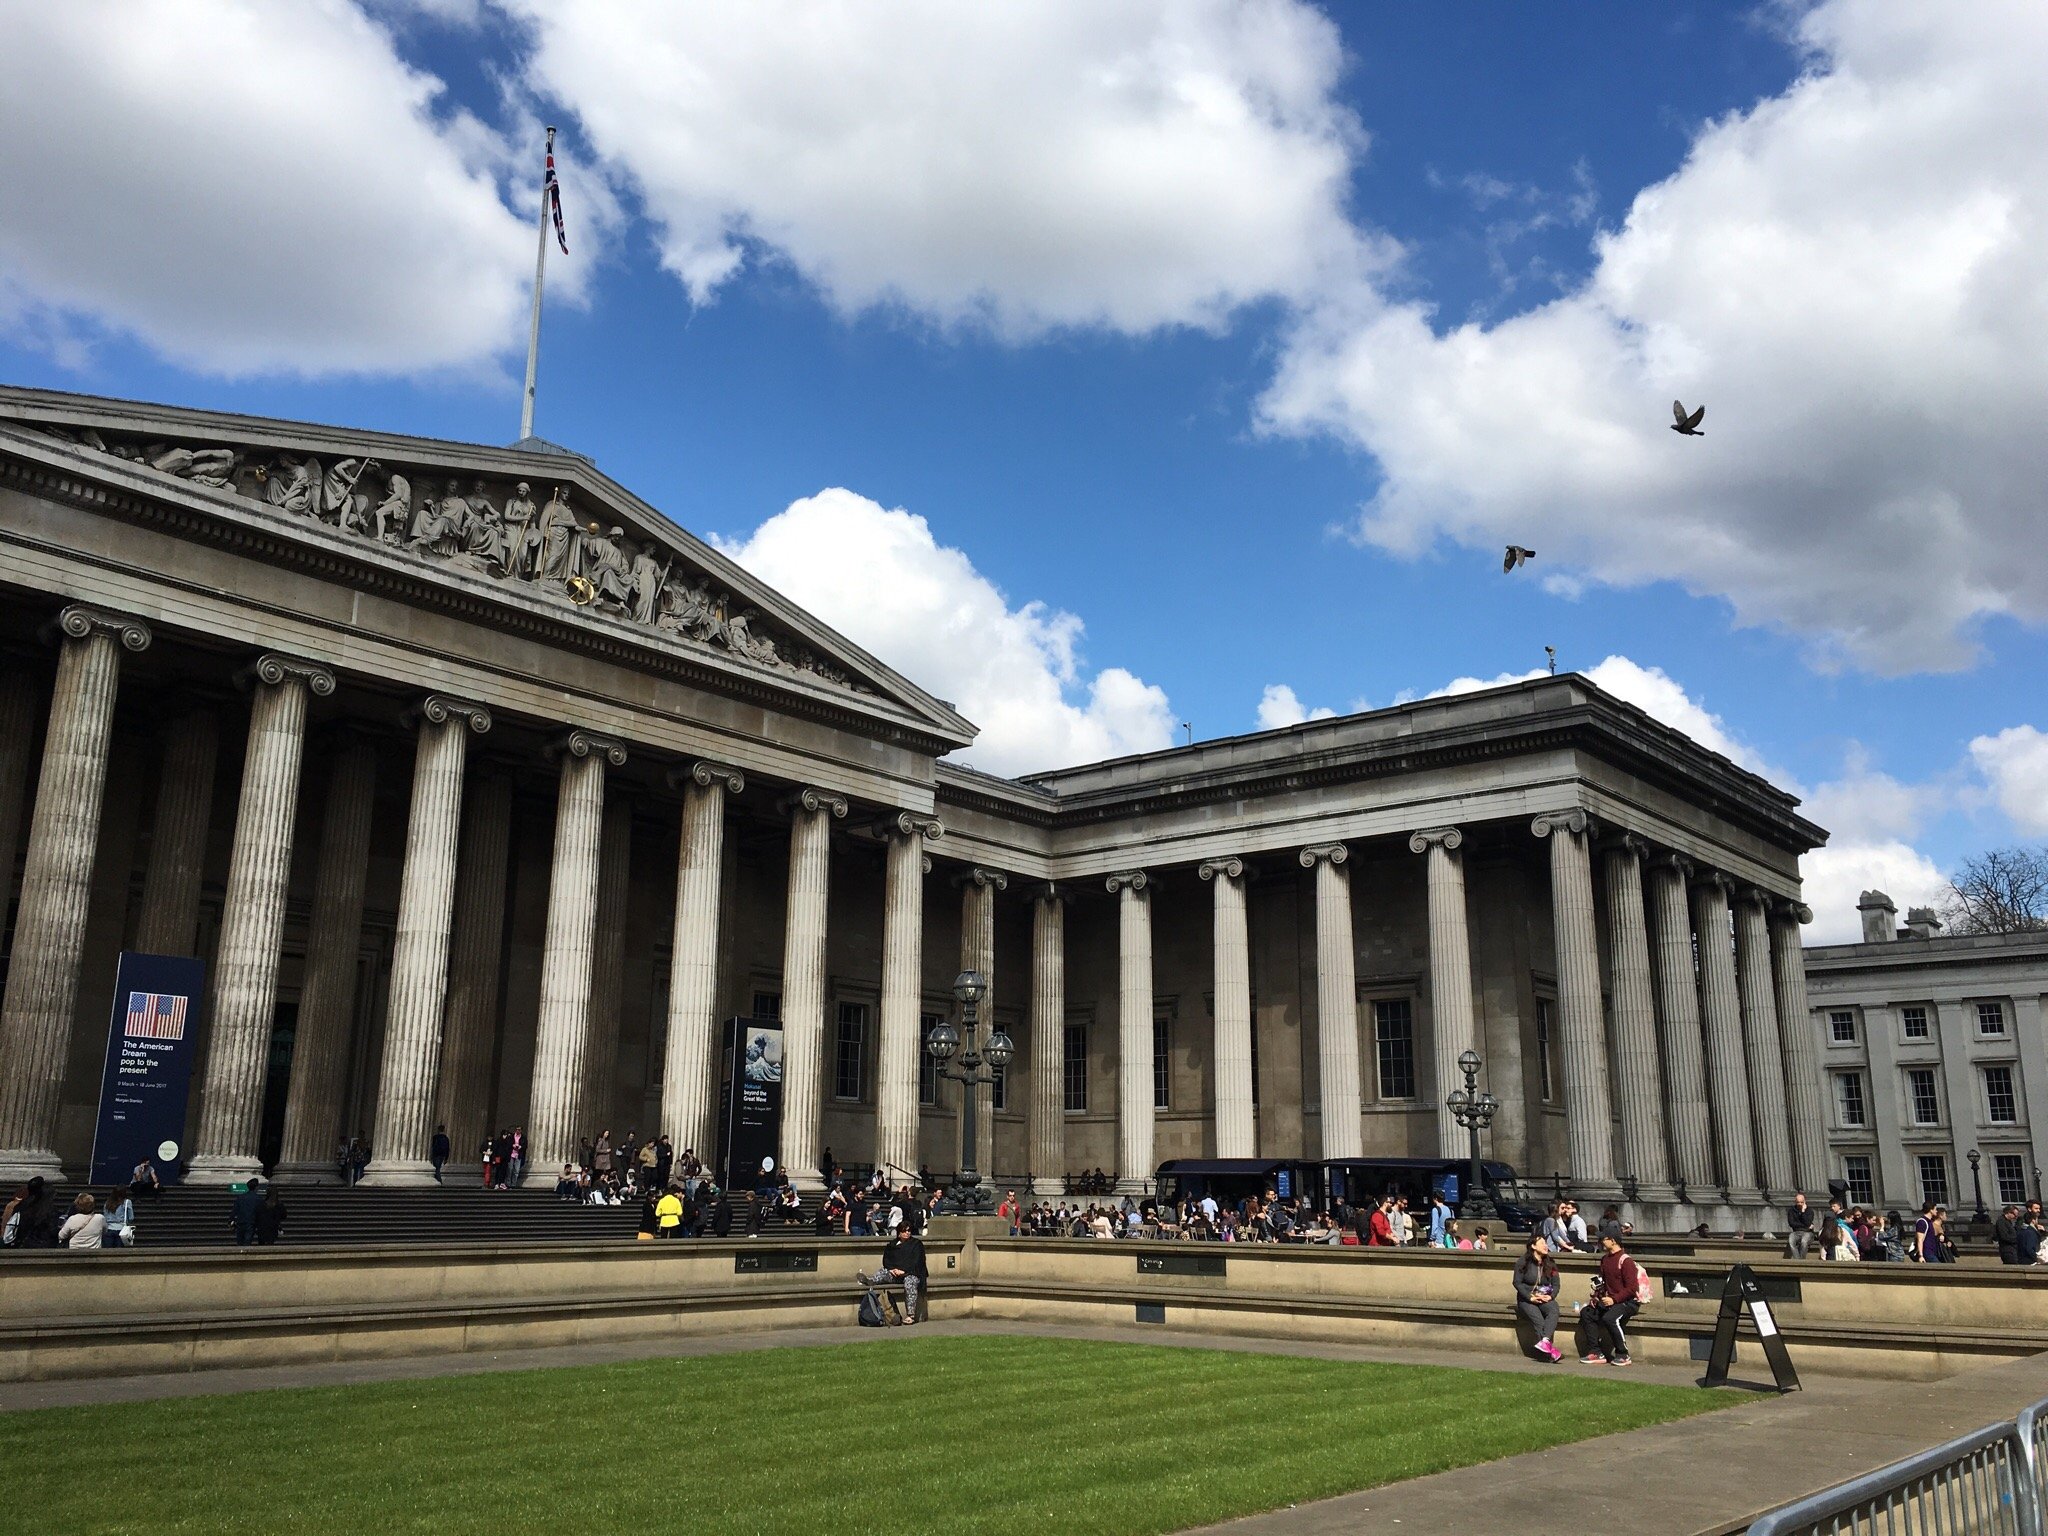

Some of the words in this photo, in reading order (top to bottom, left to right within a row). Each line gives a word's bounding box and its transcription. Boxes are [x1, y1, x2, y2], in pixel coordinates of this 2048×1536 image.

[123, 1040, 137, 1048] The
[138, 1042, 174, 1051] American
[122, 1049, 146, 1057] Dream
